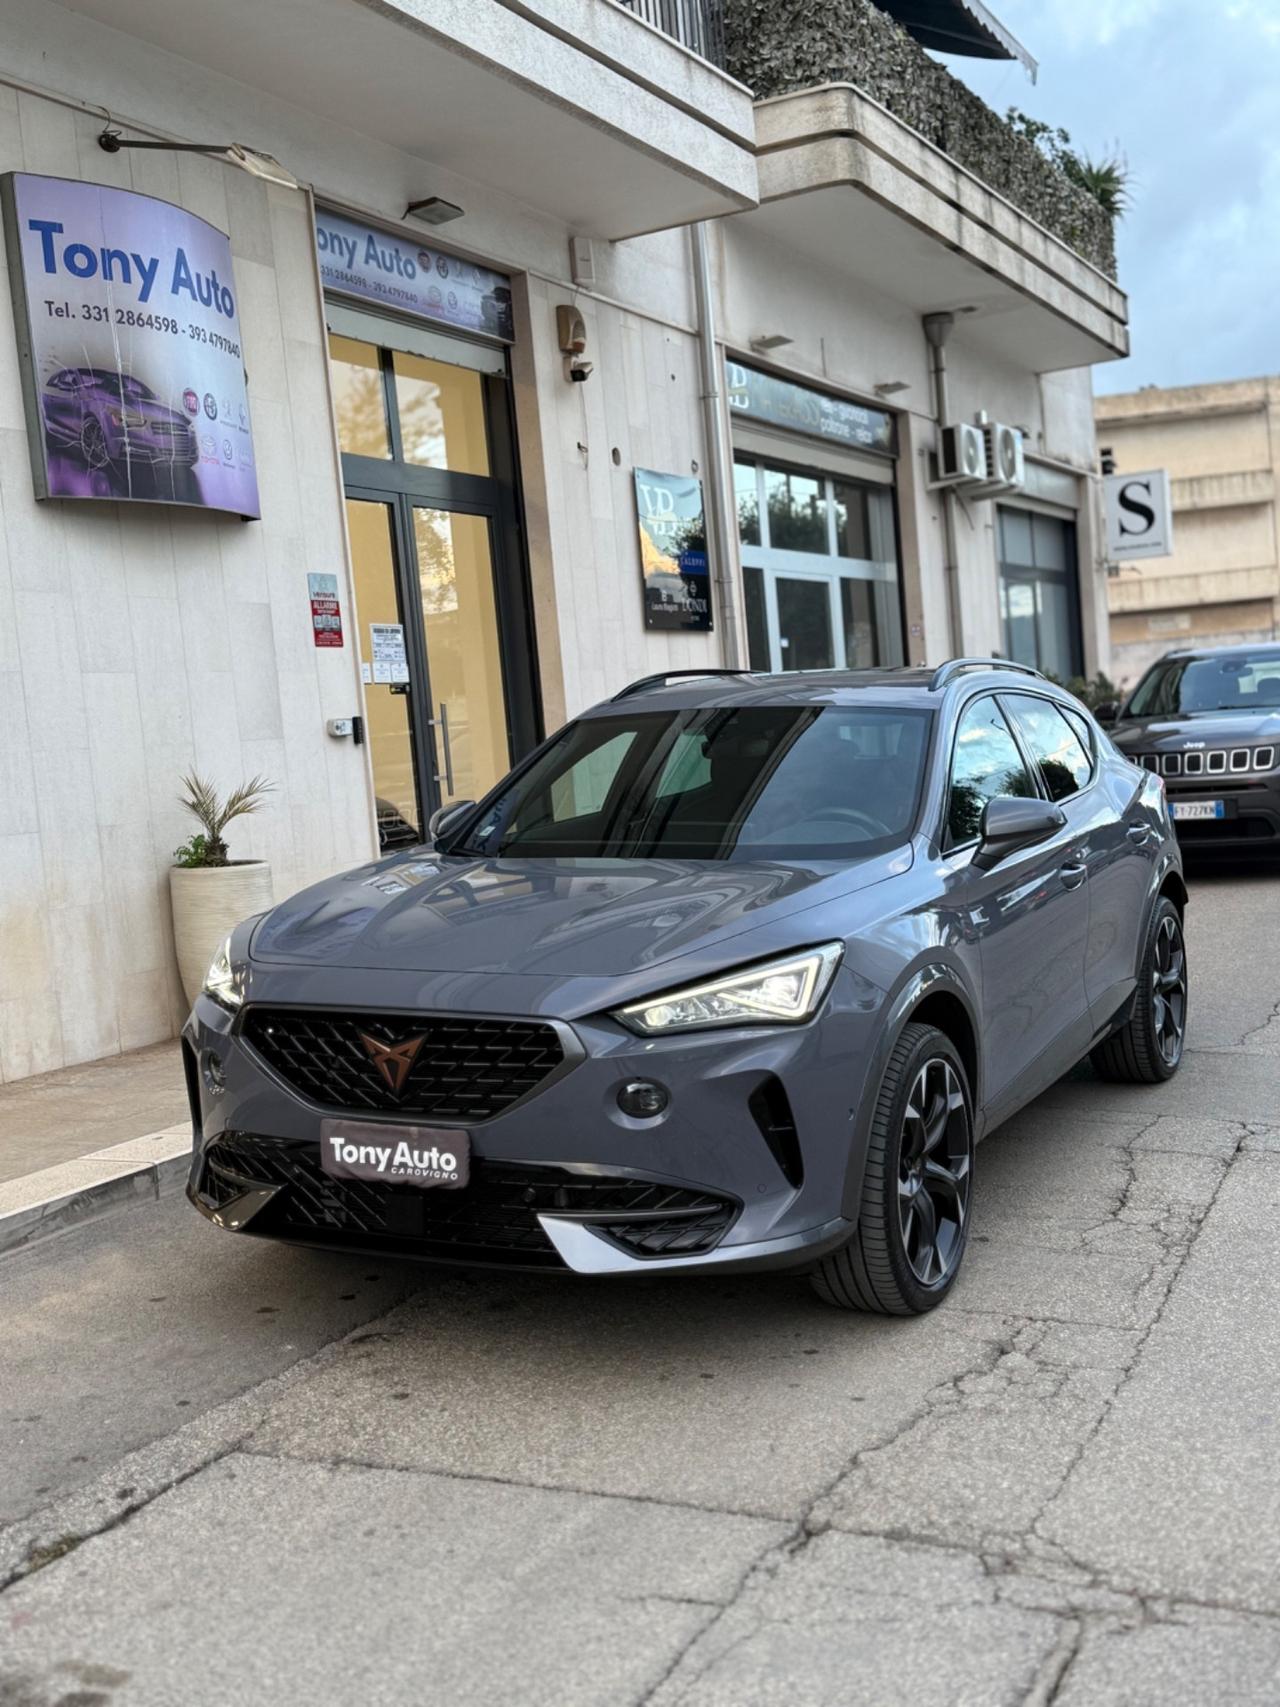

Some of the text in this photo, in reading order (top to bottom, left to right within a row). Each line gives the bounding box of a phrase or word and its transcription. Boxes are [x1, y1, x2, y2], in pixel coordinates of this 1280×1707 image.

[28, 218, 234, 319] Tony Auto
[316, 227, 417, 280] ony Auto
[44, 300, 75, 319] Tel.
[82, 304, 110, 322] 331
[115, 308, 179, 335] 2864598
[189, 324, 207, 344] 393
[208, 331, 241, 359] 4797840
[1118, 479, 1155, 538] S
[391, 1166, 458, 1181] CAROVIGNO
